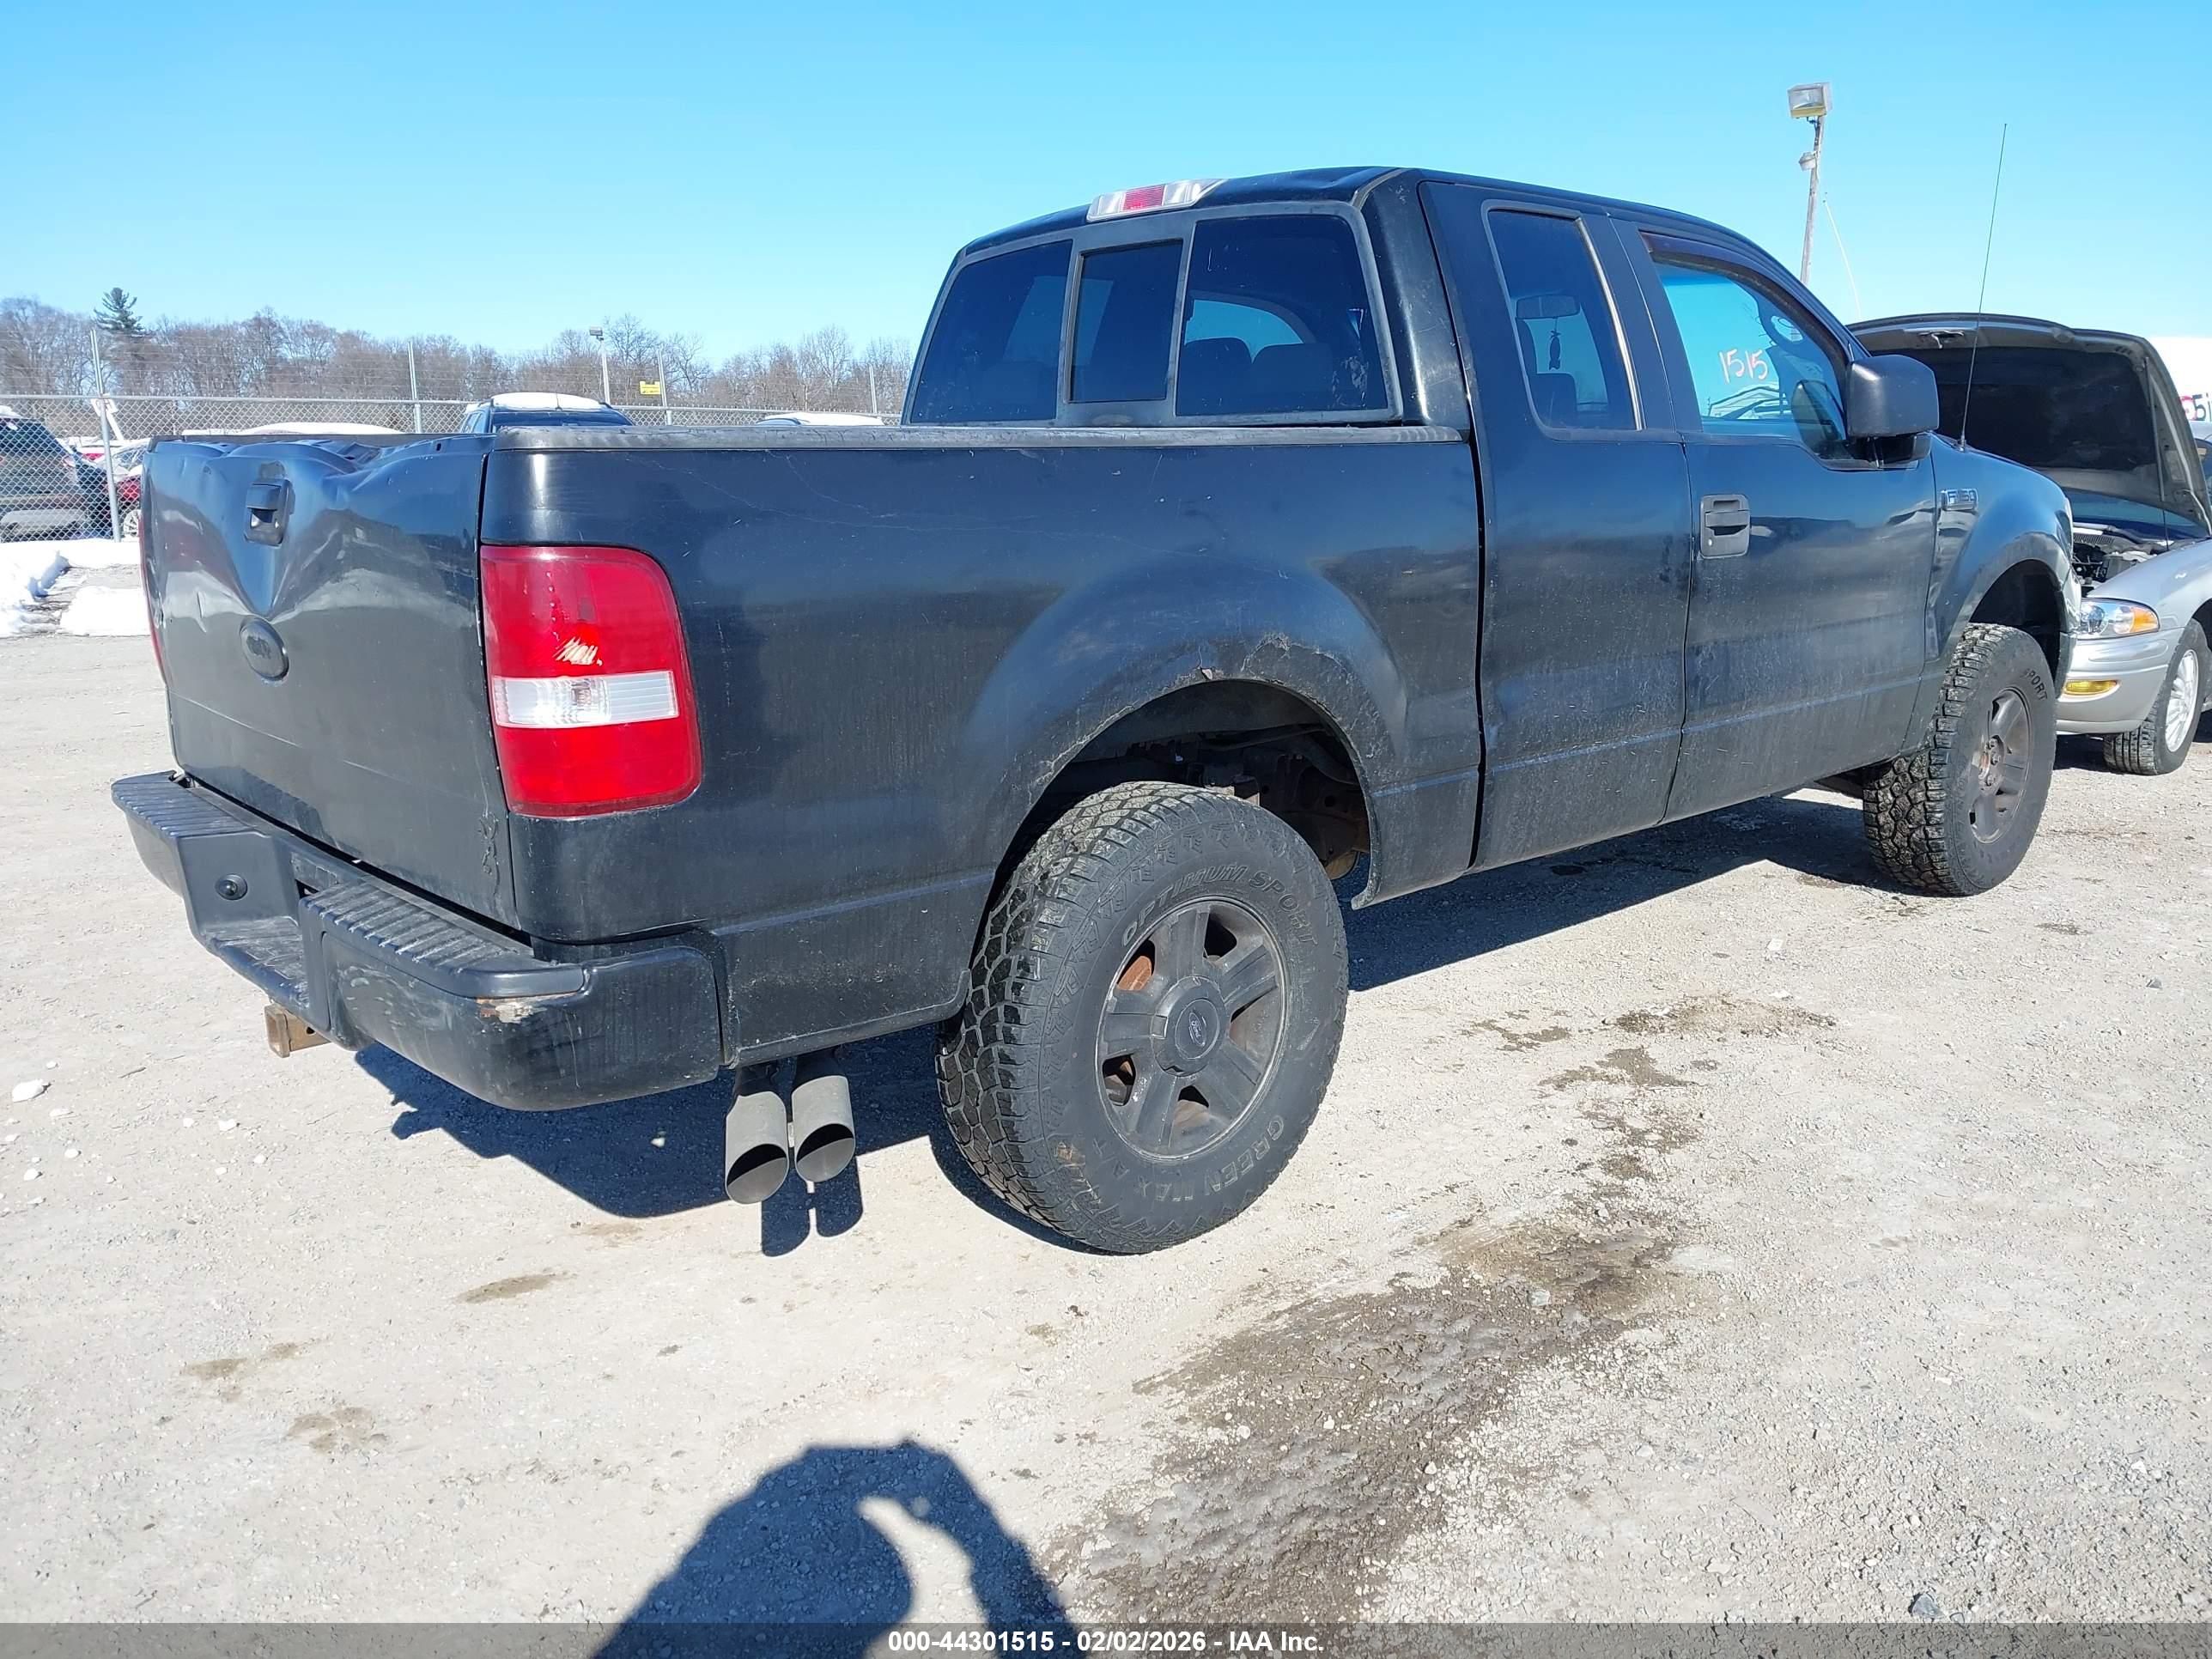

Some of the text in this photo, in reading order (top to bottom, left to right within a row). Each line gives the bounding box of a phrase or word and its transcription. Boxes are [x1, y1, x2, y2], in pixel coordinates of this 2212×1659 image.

[1718, 348, 1769, 384] 1515
[1121, 863, 1319, 947] OPTIMUM SPORT
[1203, 1115, 1285, 1197] GREEN
